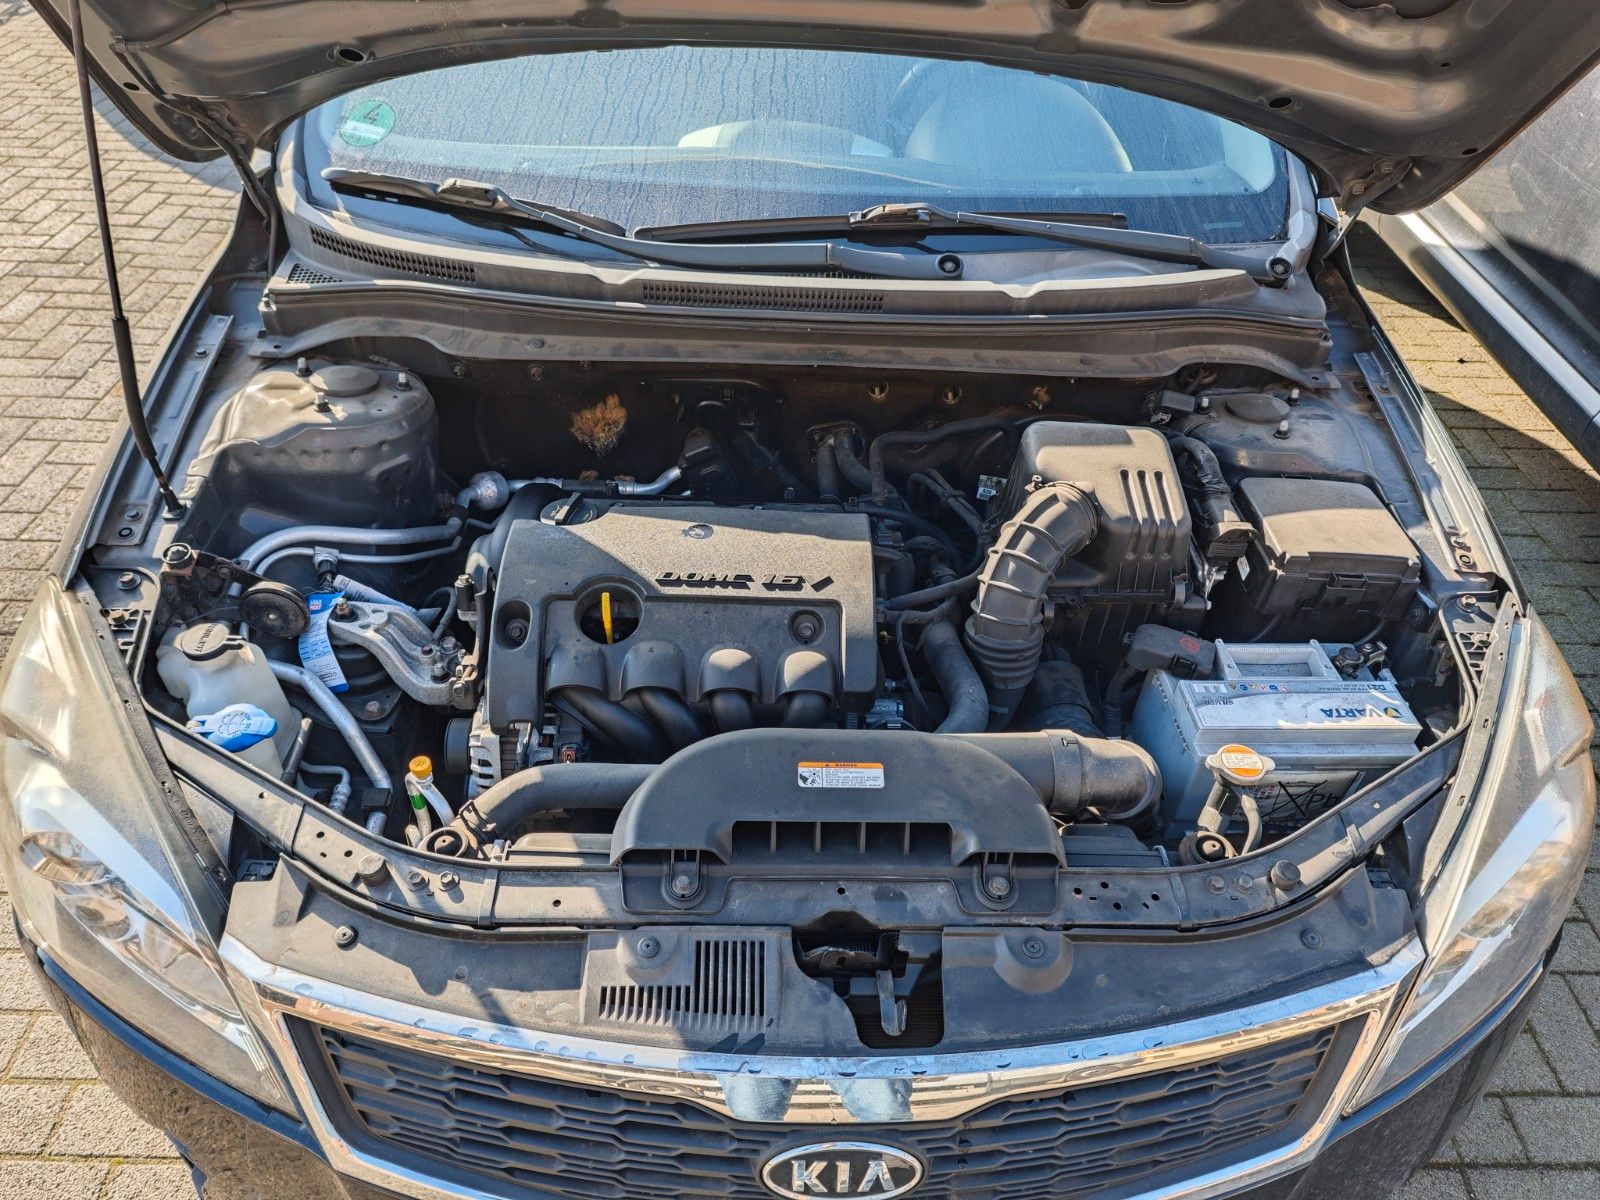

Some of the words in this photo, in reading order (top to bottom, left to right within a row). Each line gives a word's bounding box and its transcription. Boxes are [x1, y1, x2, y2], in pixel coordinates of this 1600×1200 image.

[363, 103, 383, 124] 4
[655, 571, 754, 591] DOHC
[762, 572, 835, 593] 16V
[1320, 708, 1383, 718] VARTA
[791, 1159, 896, 1193] KIA
